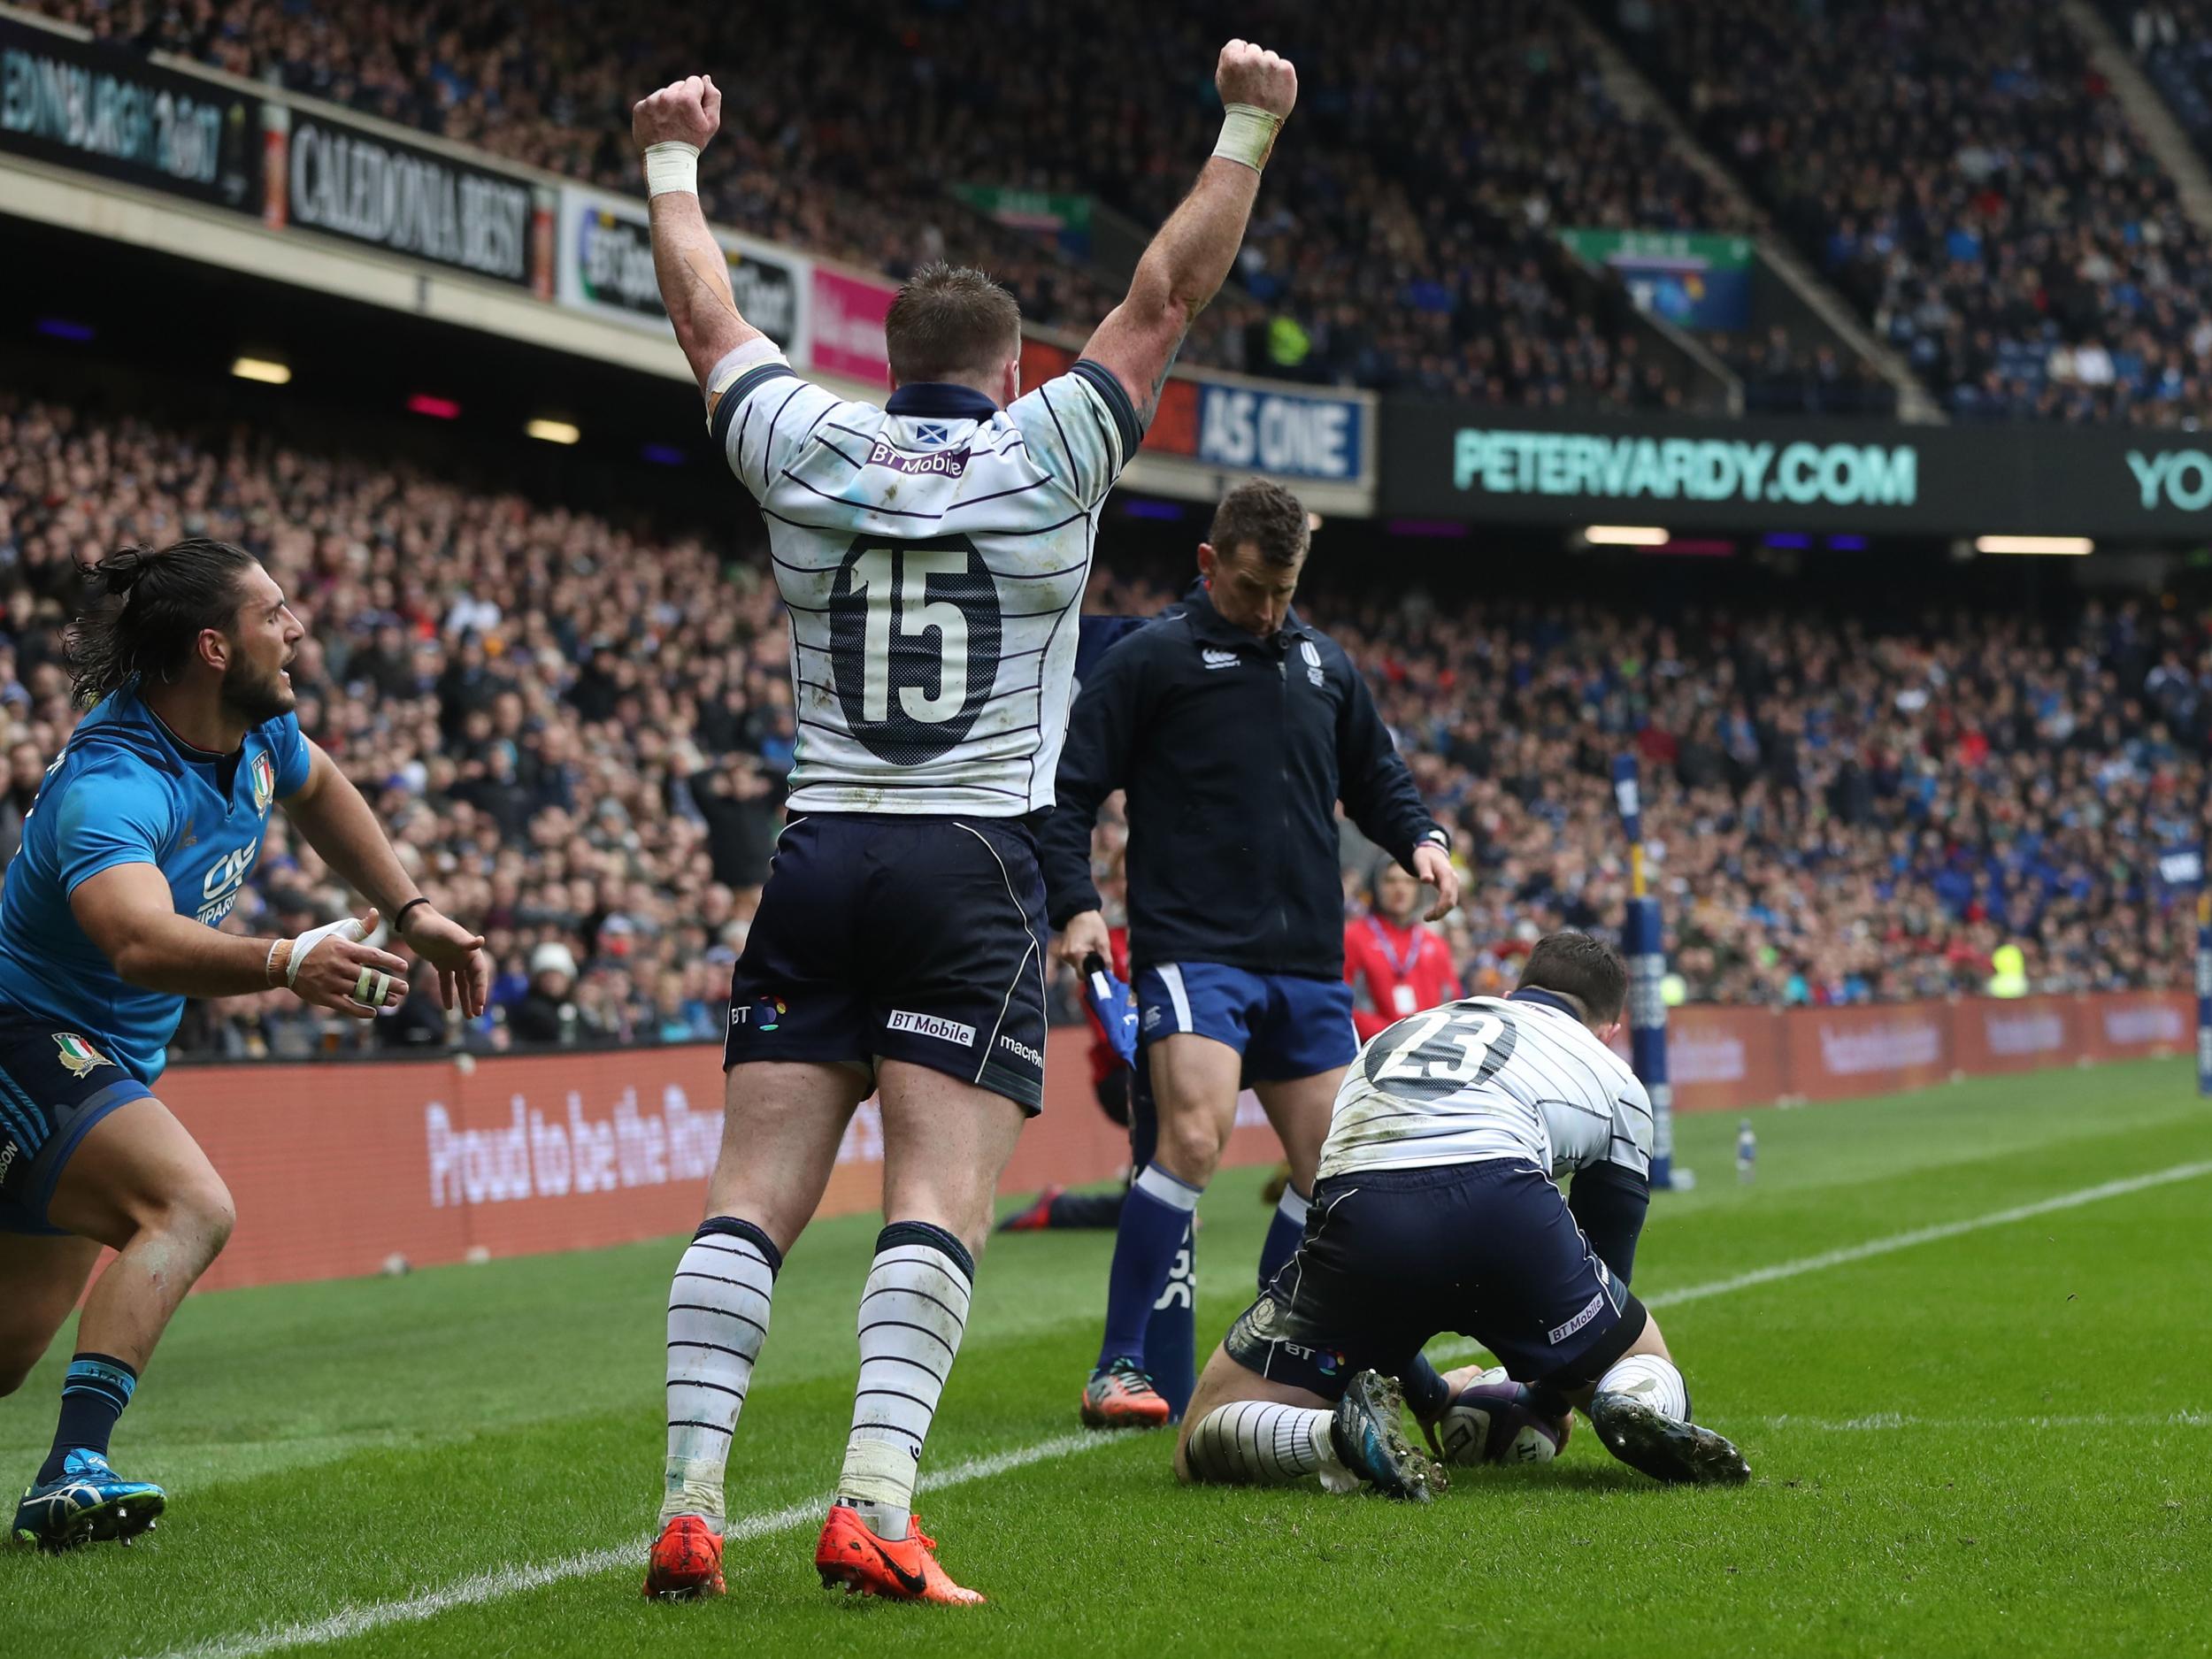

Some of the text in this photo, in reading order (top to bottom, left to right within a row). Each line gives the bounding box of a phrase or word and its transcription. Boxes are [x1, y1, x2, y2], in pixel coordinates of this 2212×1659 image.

[458, 174, 526, 279] BEST
[871, 443, 962, 475] BT Mobile
[1200, 388, 1348, 476] AS ONE
[1454, 428, 2212, 511] PETERVARDY.COM YO
[849, 549, 968, 723] 15
[732, 1006, 751, 1025] BT
[893, 1011, 969, 1043] BT Mobile
[1372, 1011, 1504, 1082] 23
[426, 1101, 531, 1208] Proud
[531, 1108, 572, 1196] to
[567, 1089, 617, 1194] be
[1285, 1341, 1316, 1360] BT
[1552, 1299, 1601, 1341] BT Mobile
